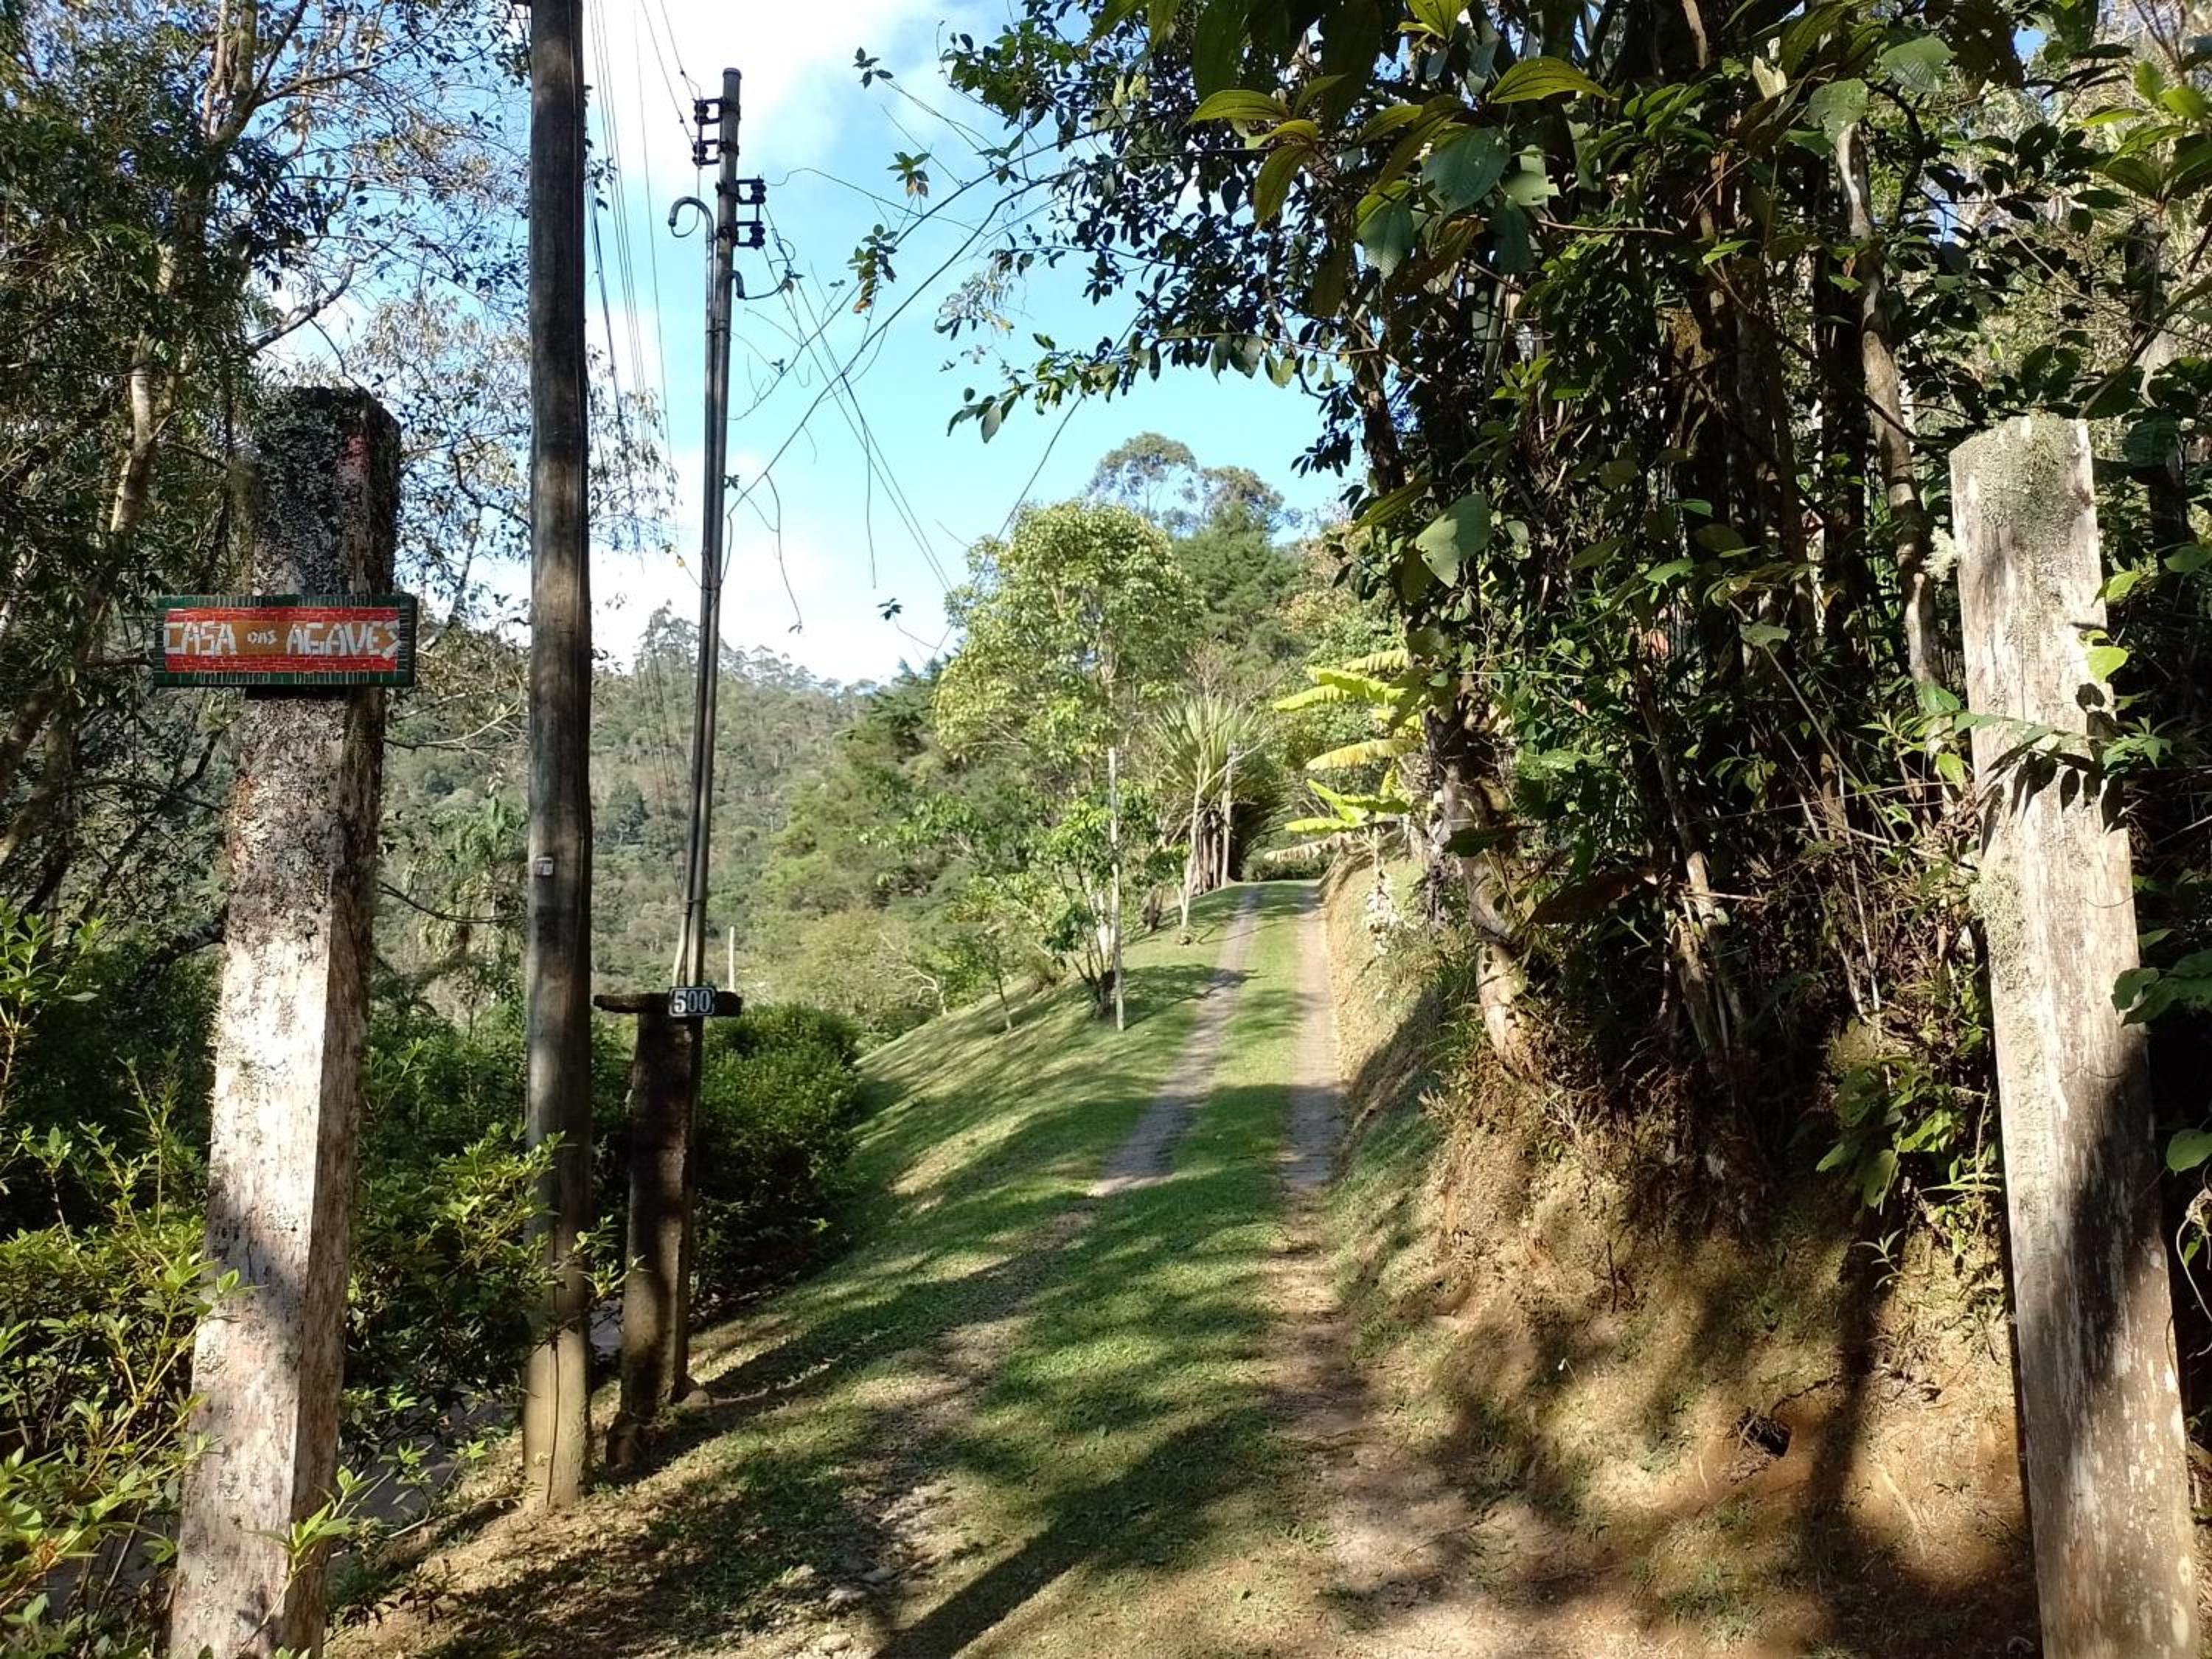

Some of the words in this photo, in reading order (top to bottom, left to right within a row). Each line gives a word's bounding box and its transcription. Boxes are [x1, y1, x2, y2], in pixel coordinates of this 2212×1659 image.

[163, 621, 237, 655] CASA
[286, 620, 402, 660] AGAVES
[674, 990, 712, 1013] 500
